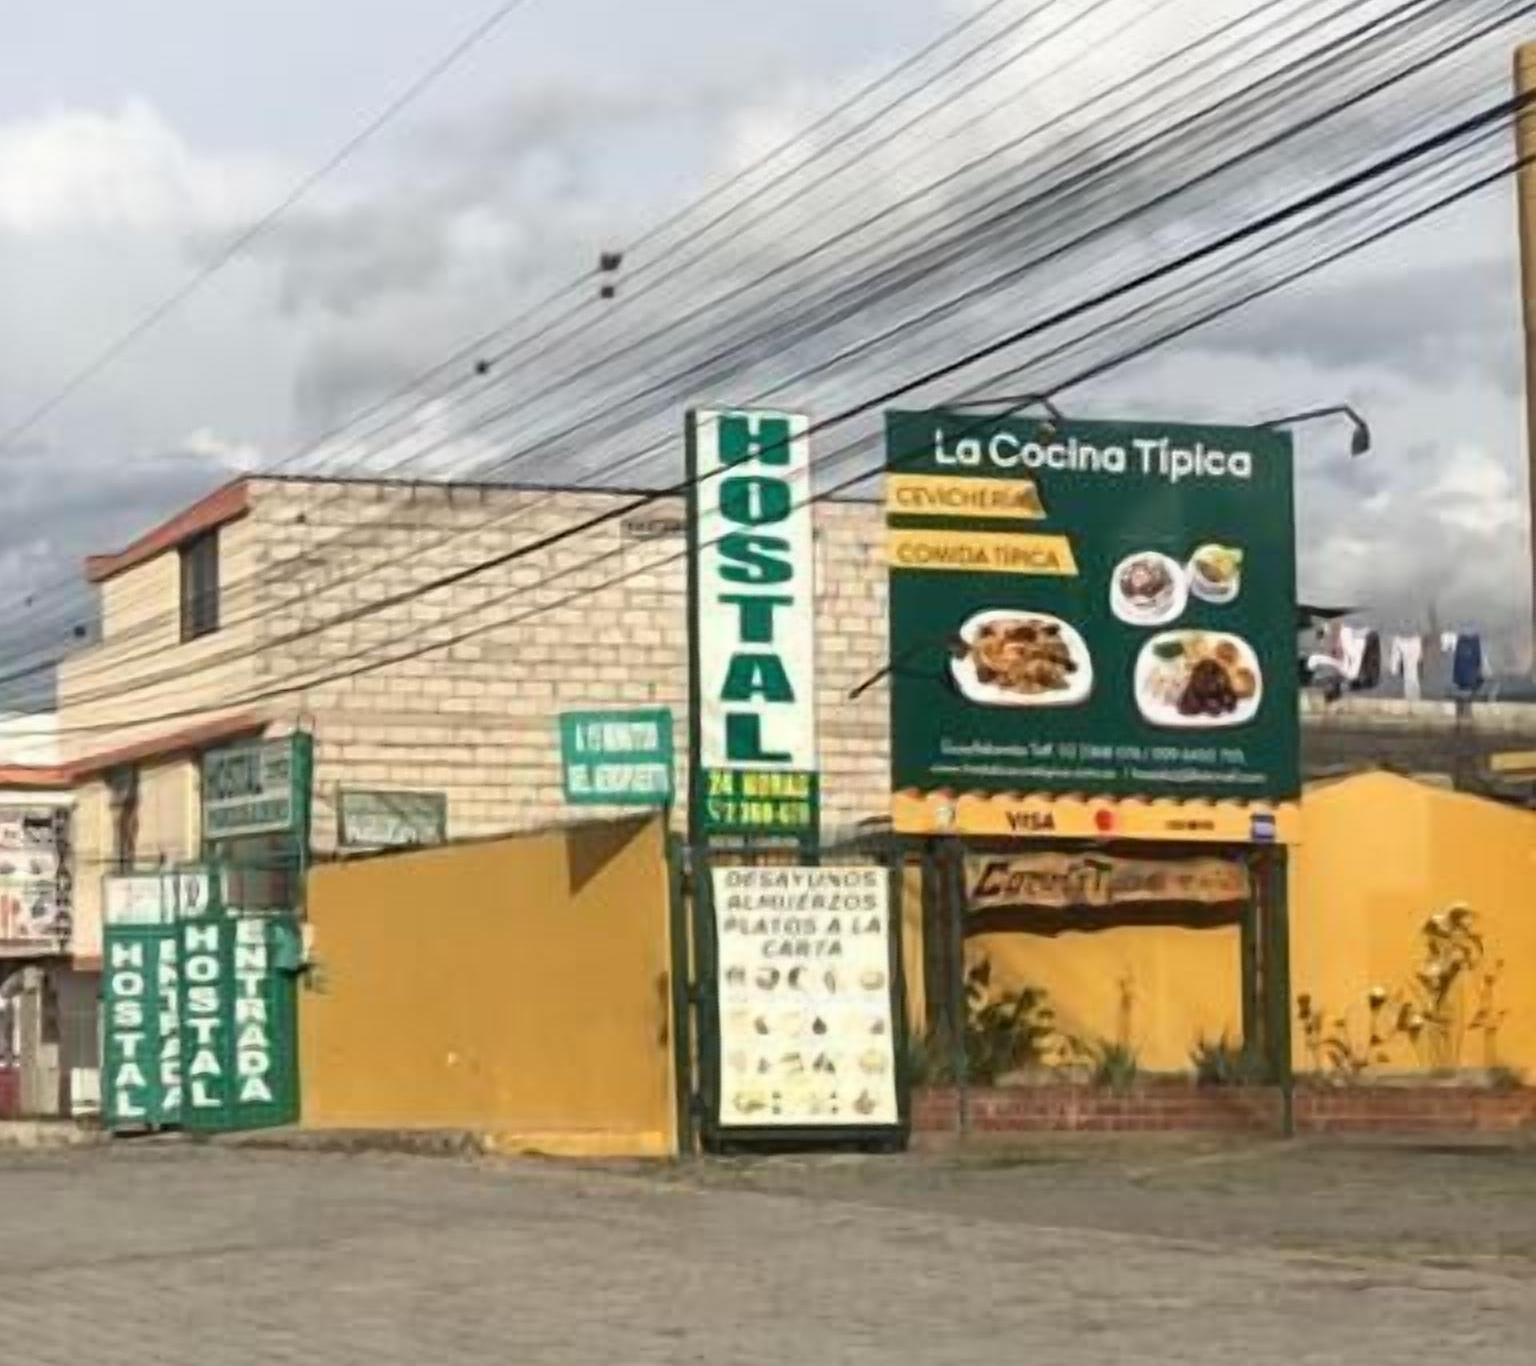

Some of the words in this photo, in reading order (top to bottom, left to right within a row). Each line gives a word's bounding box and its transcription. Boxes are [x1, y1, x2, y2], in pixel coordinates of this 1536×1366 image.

[934, 429, 982, 465] La
[988, 432, 1127, 473] Cocina
[717, 415, 796, 763] HOSTAL
[1005, 810, 1056, 832] VISA
[111, 941, 147, 1116] HOSTAL
[184, 924, 222, 1108] HOSTAL
[235, 919, 273, 1102] ENTRADA
[763, 938, 843, 957] CARTA
